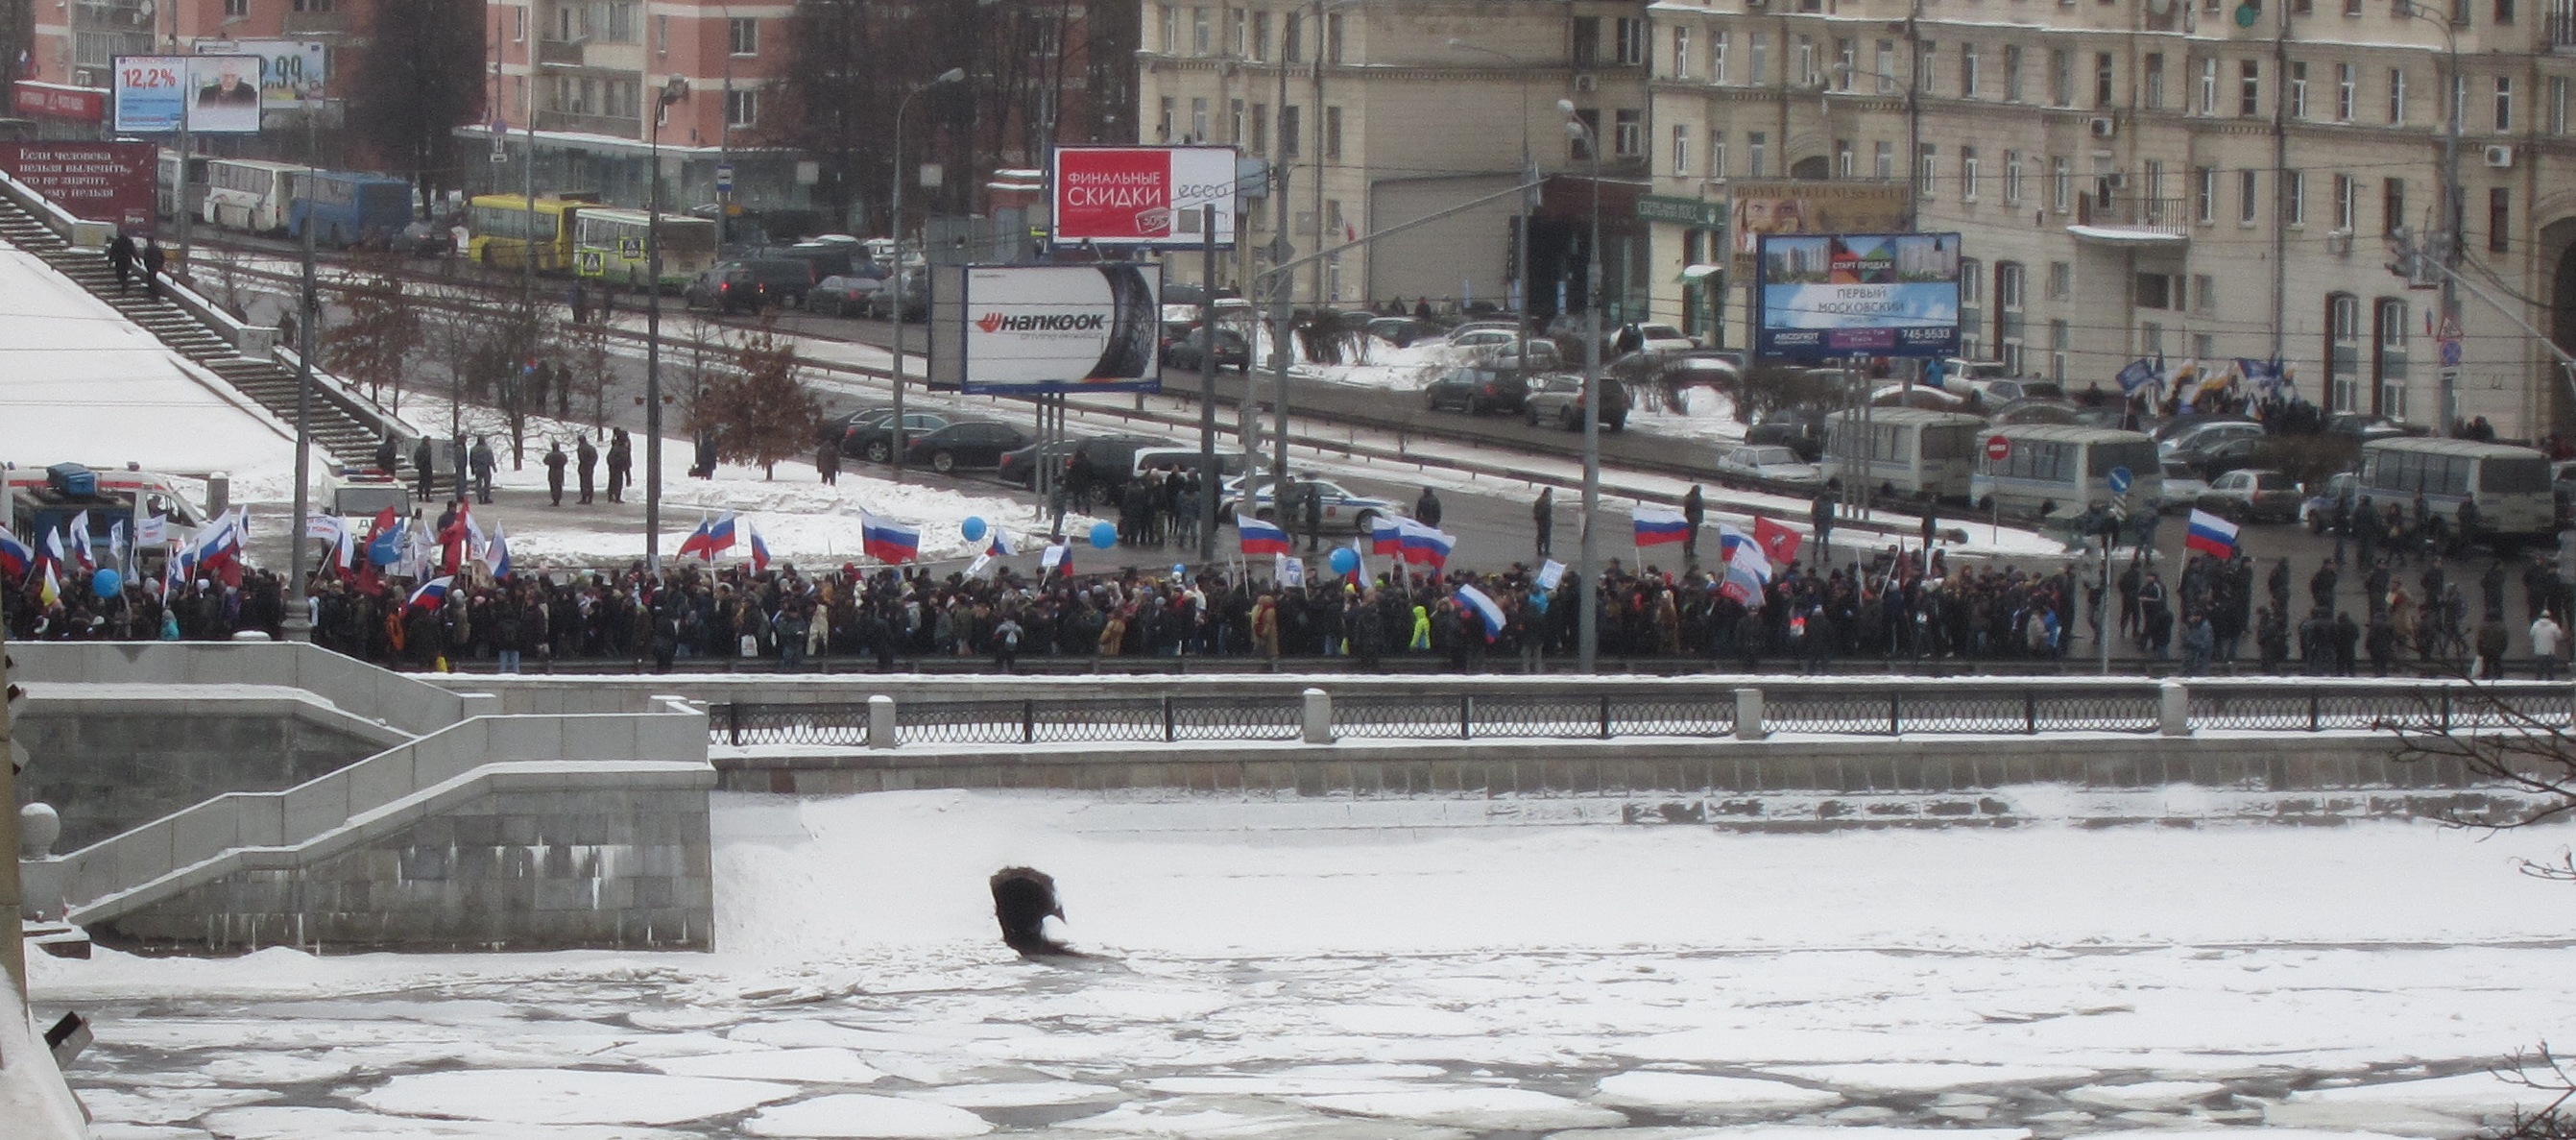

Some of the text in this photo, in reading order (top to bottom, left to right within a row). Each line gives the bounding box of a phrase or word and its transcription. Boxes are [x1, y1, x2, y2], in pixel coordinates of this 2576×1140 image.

[122, 67, 177, 91] 12,2%
[20, 148, 111, 160] Если человека
[19, 164, 61, 173] нельзя
[43, 177, 58, 185] не
[1068, 171, 1161, 185] ФИНАЛЬНЫЕ
[71, 188, 114, 198] нельзя
[1068, 186, 1161, 207] СКИДКИ
[1178, 183, 1228, 199] ecco
[1837, 286, 1887, 299] ПЕРВЫЙ
[1818, 301, 1904, 313] МОСКОВСКИЙ
